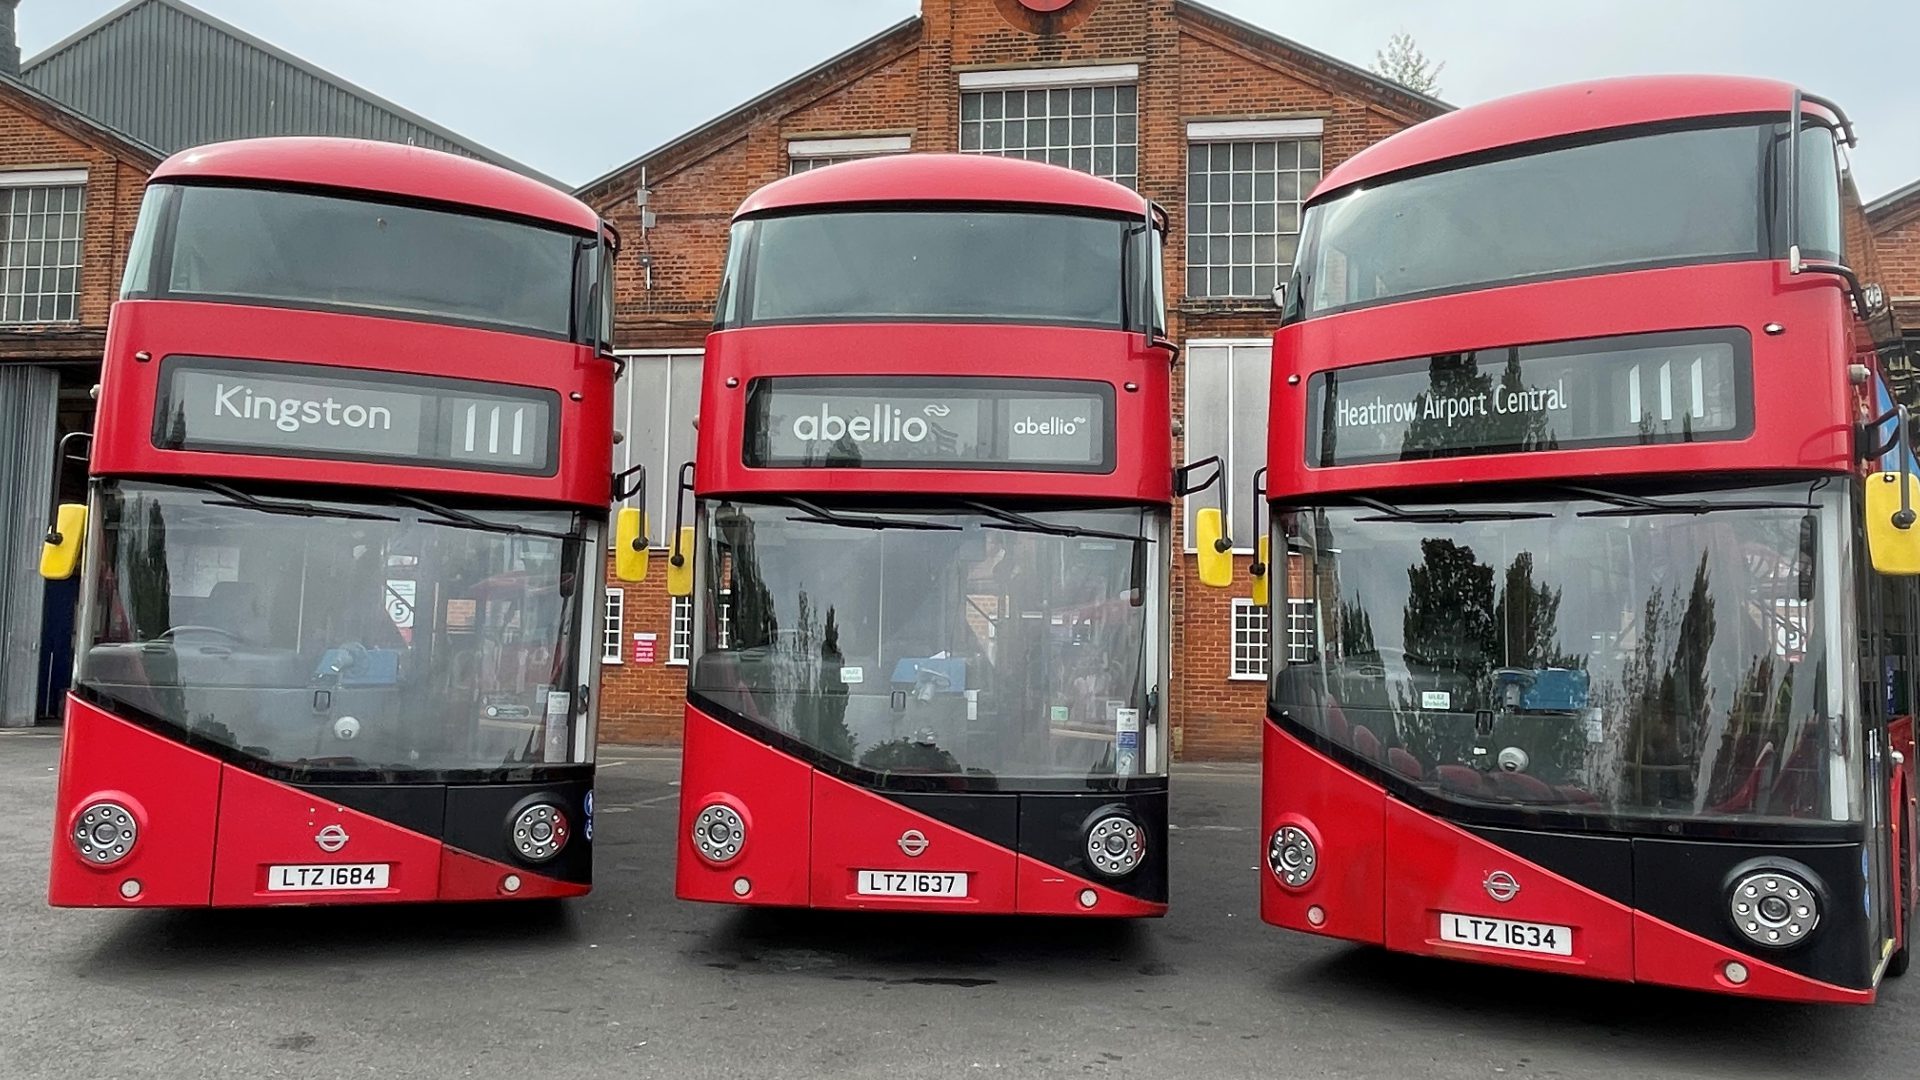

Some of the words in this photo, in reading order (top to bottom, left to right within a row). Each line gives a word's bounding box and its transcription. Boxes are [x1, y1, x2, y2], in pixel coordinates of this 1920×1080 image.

[214, 384, 391, 432] Kingston
[1338, 396, 1418, 427] Heathrow
[1423, 391, 1488, 427] Airport
[1495, 378, 1567, 415] Central
[1629, 357, 1704, 423] 111
[465, 403, 524, 455] 111
[793, 403, 928, 443] abellio
[1013, 416, 1077, 436] abellio
